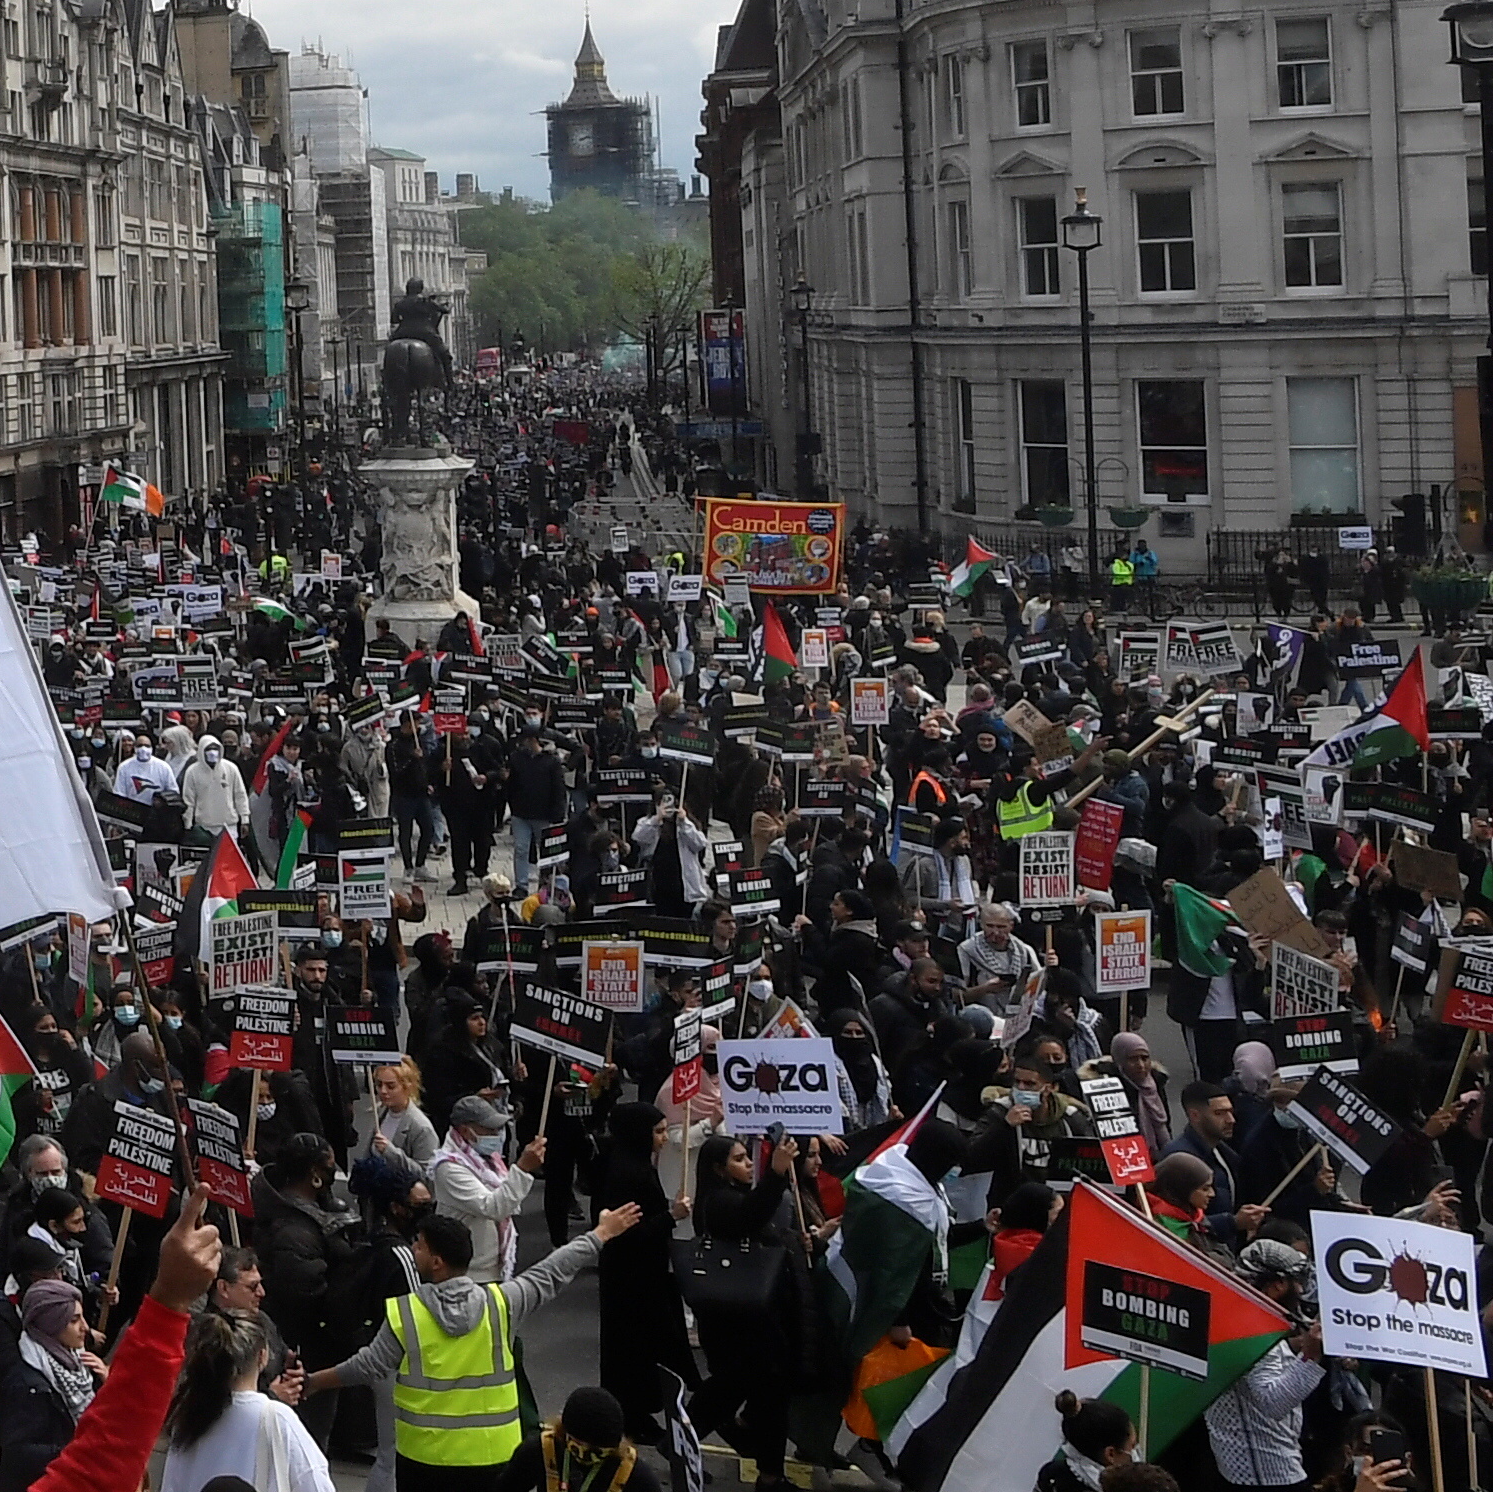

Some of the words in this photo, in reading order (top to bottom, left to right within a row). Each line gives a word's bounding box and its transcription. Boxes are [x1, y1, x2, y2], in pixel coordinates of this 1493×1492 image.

[713, 506, 807, 534] Camden
[1340, 531, 1370, 539] Gza
[628, 575, 655, 585] Gza
[671, 580, 700, 591] Gza
[186, 592, 219, 603] Gza
[1195, 644, 1234, 660] FREE
[1351, 643, 1380, 655] Free
[1337, 653, 1399, 668] Palestine
[181, 678, 217, 693] FREE
[599, 770, 646, 781] SANCTIONS
[1024, 835, 1038, 849] FREE
[1039, 835, 1069, 848] PALESTINE
[1023, 850, 1070, 863] EXIST!
[1023, 863, 1070, 875] RESIST!
[601, 872, 646, 885] SANCTIONS
[736, 879, 772, 893] BOMBING
[344, 883, 385, 895] FREE
[617, 883, 629, 893] ON
[1023, 875, 1069, 899] RETURN!
[343, 893, 386, 901] PALESTINE
[213, 920, 231, 938] FREE
[234, 914, 272, 935] PALESTINE
[214, 930, 274, 952] EXIST!
[1113, 931, 1135, 944] END
[214, 945, 274, 964] RESIST!
[1102, 943, 1145, 957] ISRAELI
[601, 959, 626, 971] END
[1106, 955, 1141, 967] STATE
[1276, 946, 1296, 969] FREE
[1296, 957, 1334, 986] PALESTINE
[214, 958, 274, 990] RETURN!
[588, 969, 637, 981] ISRAELI
[1101, 966, 1146, 979] TERROR
[593, 980, 631, 992] STATE
[1276, 964, 1333, 1001] EXIST!
[525, 982, 604, 1023] SANCTIONS
[586, 990, 637, 1002] TERROR
[1276, 980, 1333, 1012] RESIST!
[239, 996, 290, 1015] FREEDOM
[235, 1014, 291, 1035] PALESTINE
[551, 1008, 571, 1025] ON
[336, 1021, 386, 1036] BOMBING
[1296, 1019, 1327, 1032] STOP
[242, 1034, 280, 1049] الحرية
[1285, 1029, 1343, 1049] BOMBING
[236, 1049, 284, 1063] لفلسطين
[1299, 1046, 1331, 1060] GAZA
[723, 1055, 829, 1093] Gza
[728, 1102, 752, 1116] Stop
[754, 1102, 770, 1114] the
[772, 1104, 833, 1115] massacre
[1091, 1091, 1130, 1113] FREEDOM
[1319, 1071, 1392, 1137] SANCTIONS
[1336, 1104, 1357, 1126] ON
[116, 1116, 176, 1151] FREEDOM
[195, 1114, 237, 1146] FREEDOM
[1096, 1115, 1140, 1138] PALESTINE
[108, 1137, 174, 1175] PALESTINE
[197, 1137, 244, 1171] PALESTINE
[114, 1162, 156, 1188] الحرية
[104, 1181, 159, 1206] لفلسطين
[1324, 1237, 1470, 1312] Gza
[1122, 1272, 1170, 1301] STOP
[1101, 1288, 1191, 1329] BOMBING
[1121, 1312, 1169, 1342] GAZA
[1331, 1307, 1382, 1332] Stop
[1386, 1313, 1415, 1333] the
[1418, 1322, 1475, 1346] massacre
[1128, 1339, 1143, 1354] FOA
[1345, 1342, 1365, 1352] Stop
[1366, 1344, 1380, 1353] the
[1381, 1346, 1396, 1355] War
[1397, 1348, 1428, 1359] Coalition
